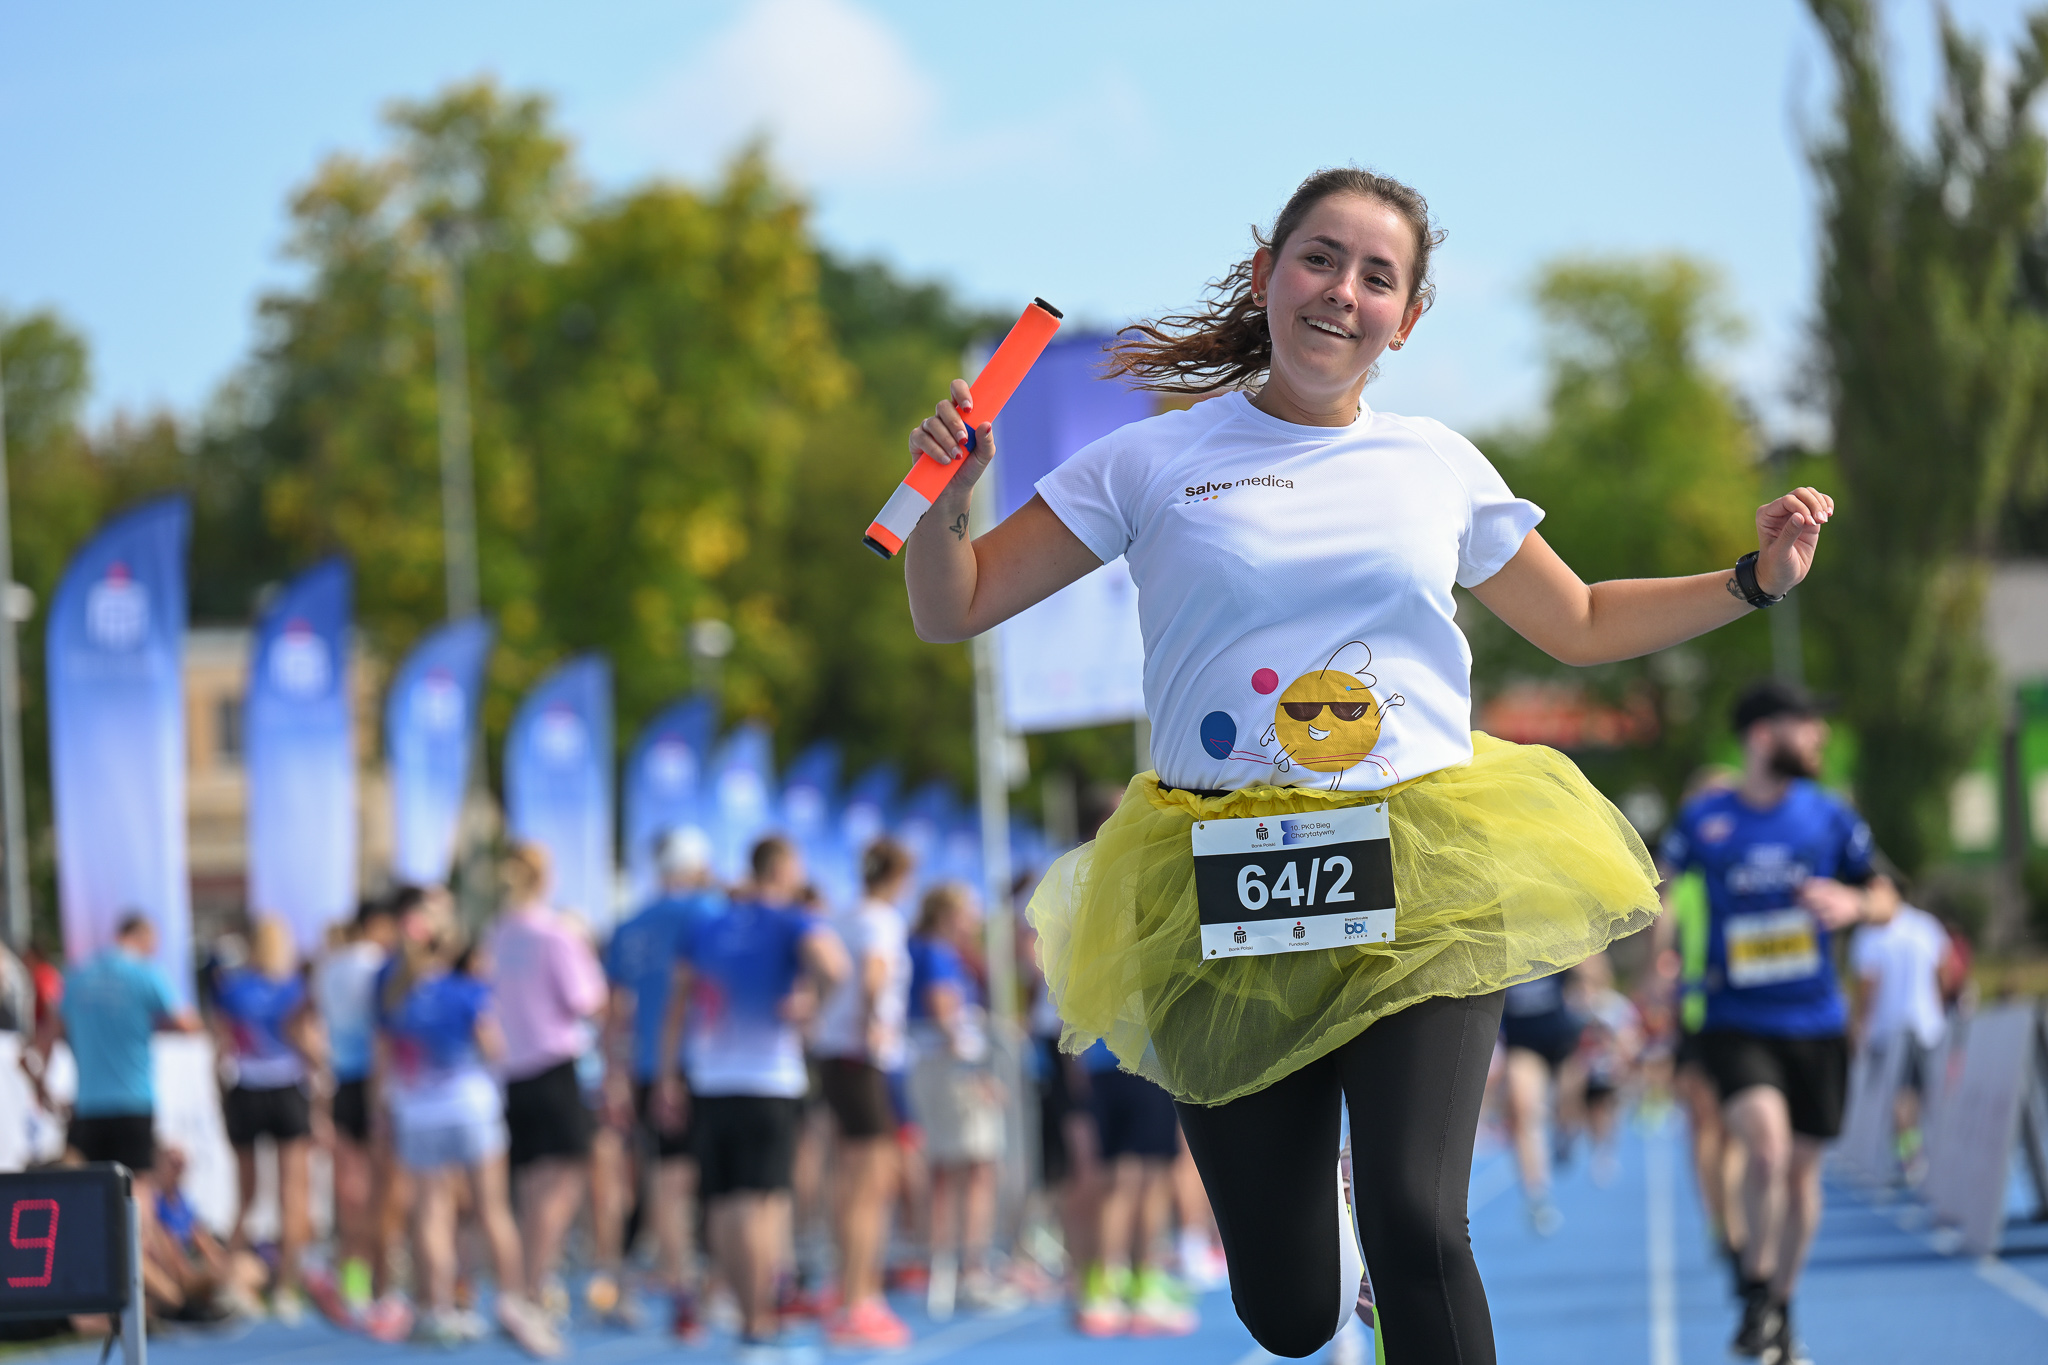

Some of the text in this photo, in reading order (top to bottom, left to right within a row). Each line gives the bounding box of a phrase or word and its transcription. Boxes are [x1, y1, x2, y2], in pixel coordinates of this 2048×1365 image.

[1185, 475, 1294, 497] salve medica
[1290, 829, 1336, 839] Charytatywny
[1236, 855, 1356, 911] 64/2
[7, 1199, 60, 1287] 9
